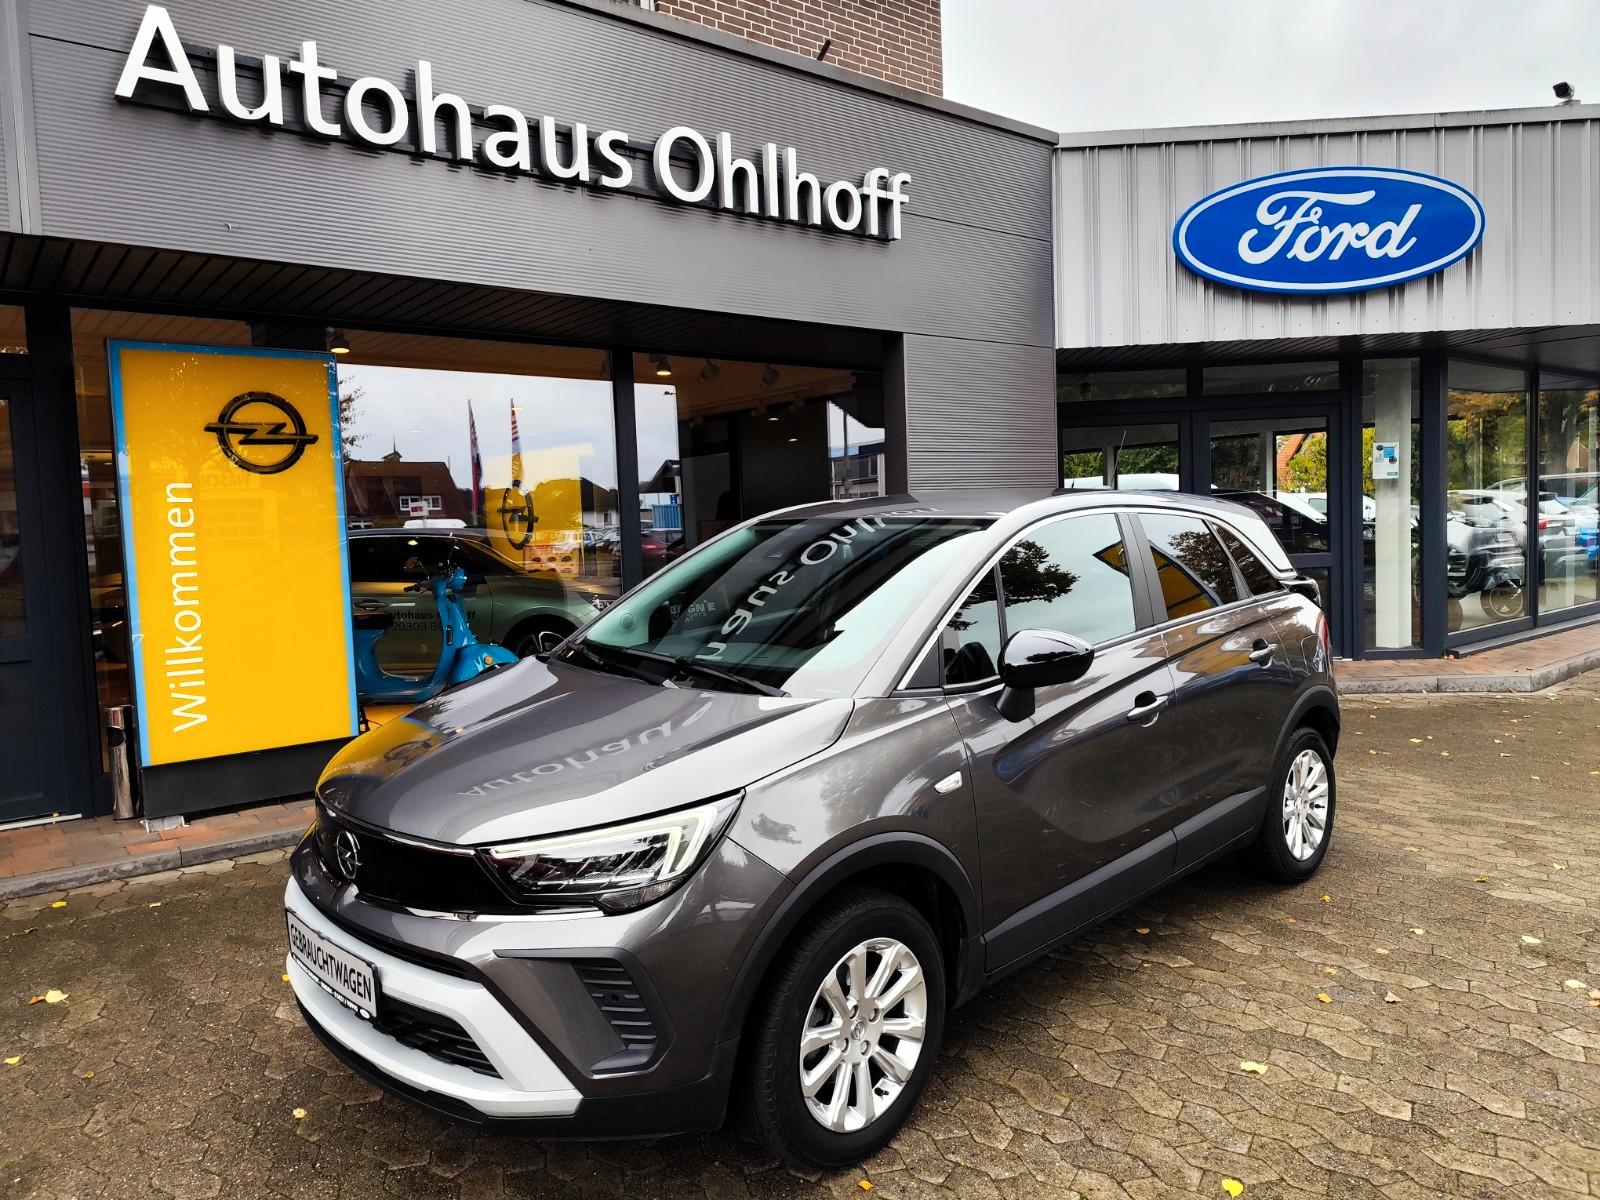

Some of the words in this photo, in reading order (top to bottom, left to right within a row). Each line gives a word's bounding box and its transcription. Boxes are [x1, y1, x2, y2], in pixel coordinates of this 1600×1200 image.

[114, 4, 633, 189] Autohaus
[652, 126, 911, 240] Ohlhoff
[1237, 189, 1422, 265] Ford
[164, 481, 208, 734] Willkommen
[391, 610, 433, 620] utohaus
[290, 923, 372, 1003] GEBRAUCHTWAGEN
